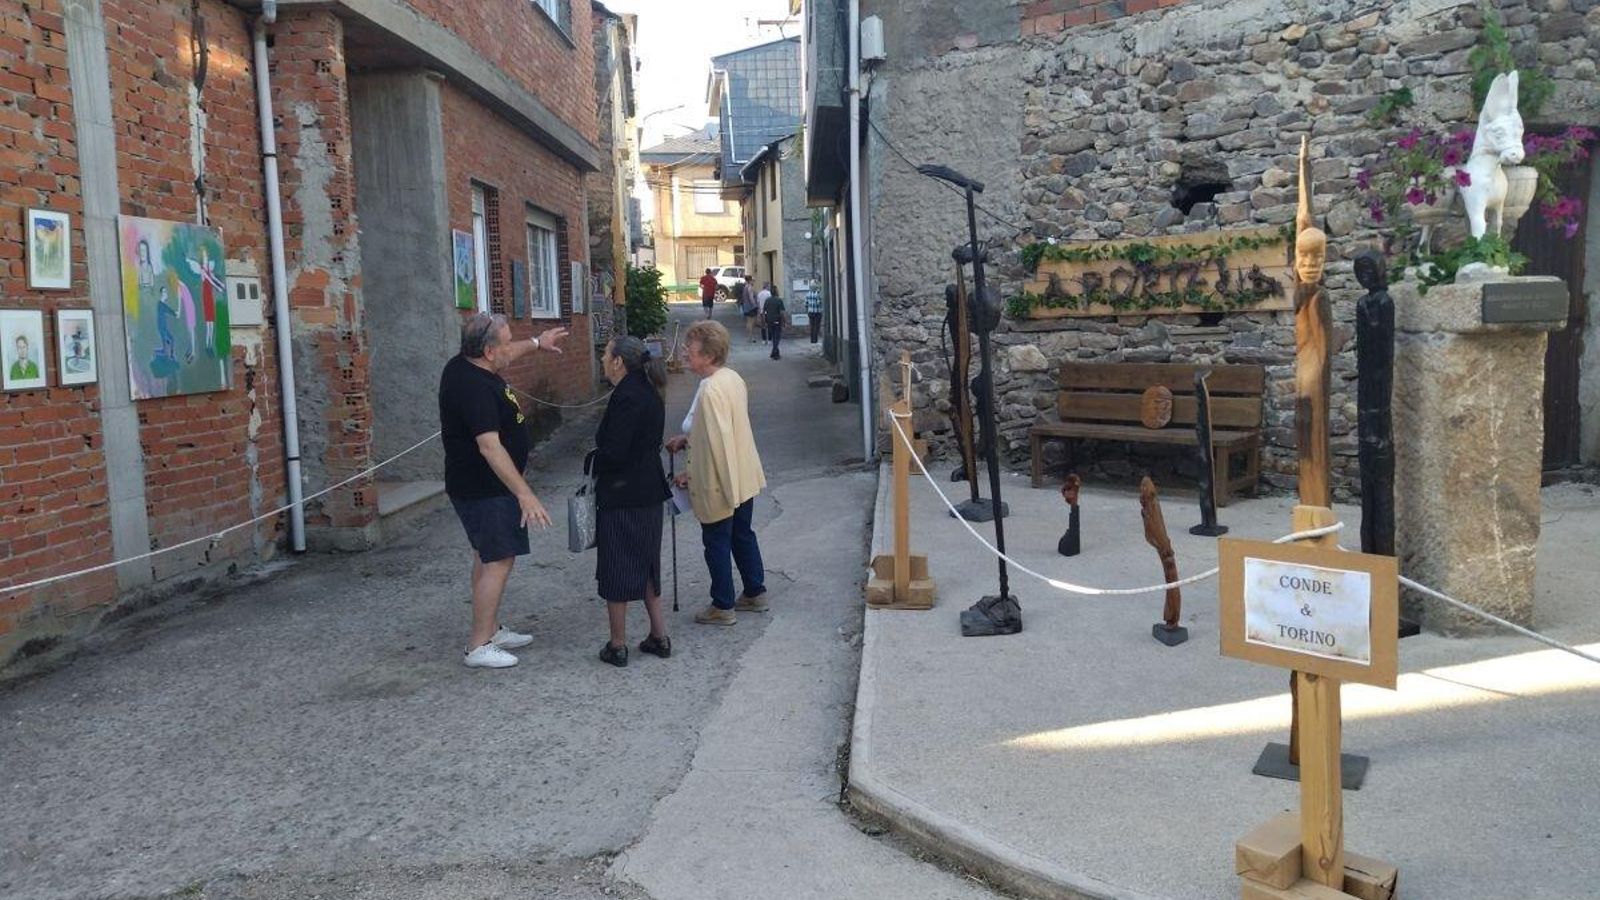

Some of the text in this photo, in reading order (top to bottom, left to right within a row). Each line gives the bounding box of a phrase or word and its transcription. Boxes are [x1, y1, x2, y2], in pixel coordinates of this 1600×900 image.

[1279, 575, 1333, 595] CONDE
[1300, 603, 1313, 617] &
[1277, 624, 1336, 648] TORINO
